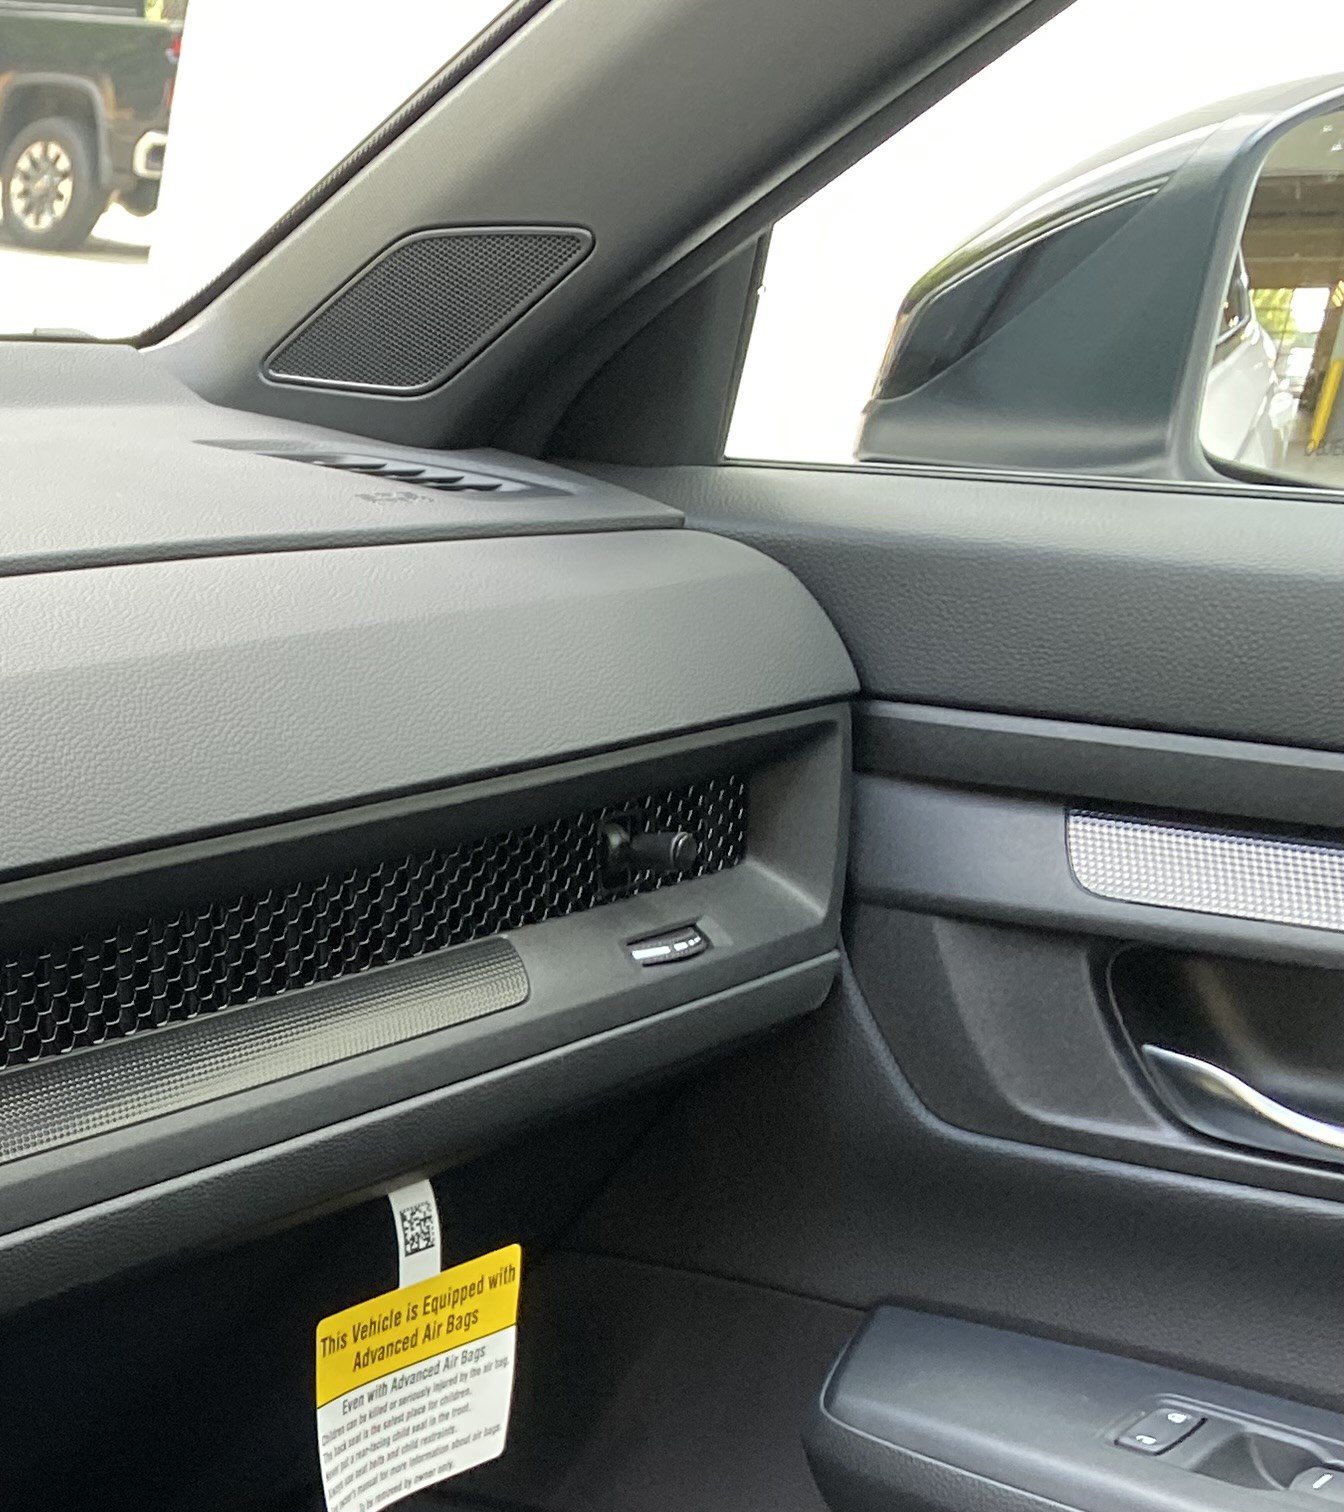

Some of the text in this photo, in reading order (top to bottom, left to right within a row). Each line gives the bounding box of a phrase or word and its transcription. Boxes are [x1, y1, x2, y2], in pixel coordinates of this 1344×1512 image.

[320, 1264, 516, 1359] This Vehicle is Equipped with
[352, 1308, 480, 1373] Advanced Air Bags
[342, 1346, 486, 1416] Even with Advanced Air Bags
